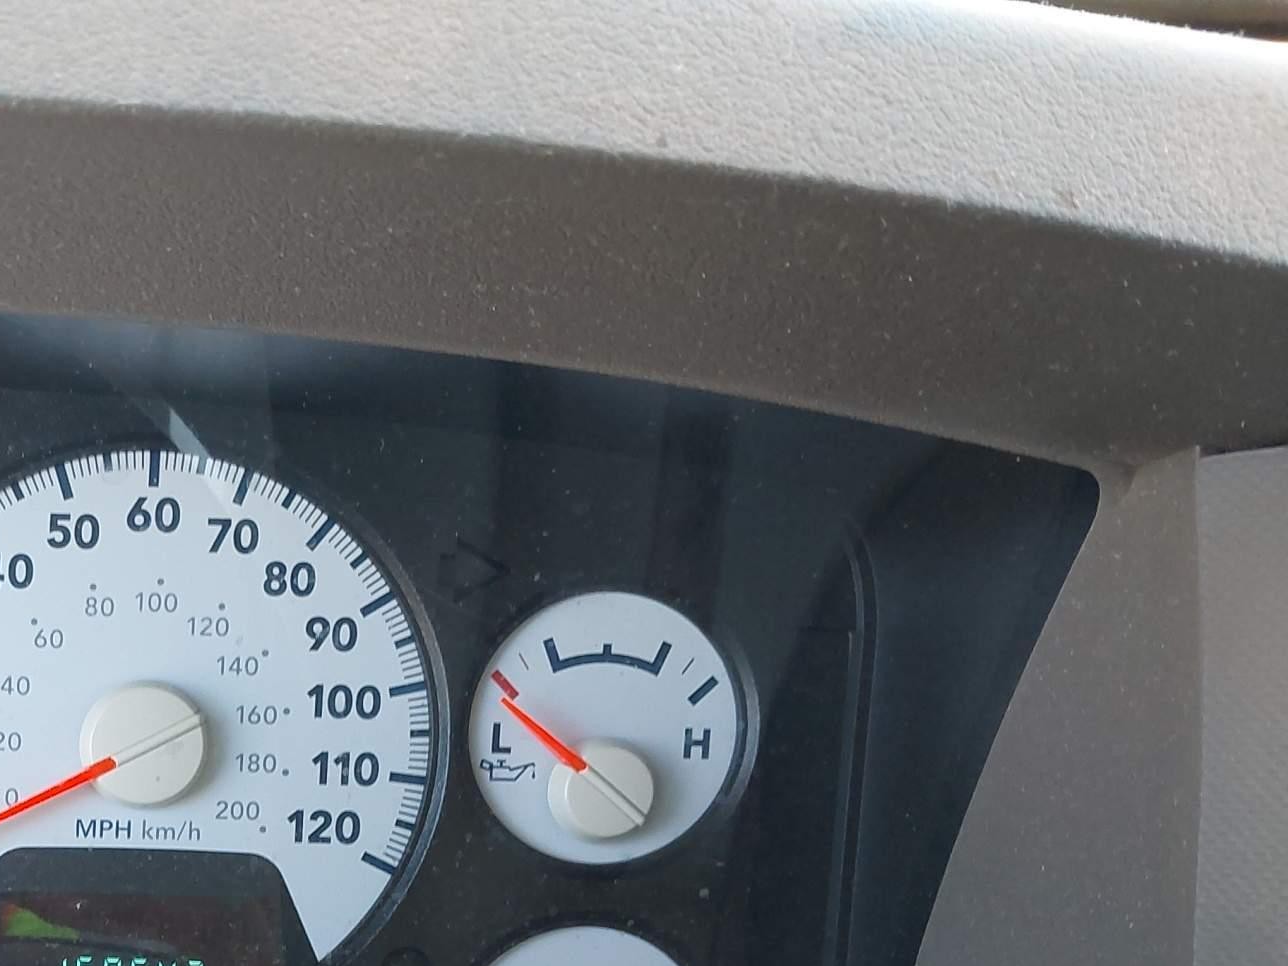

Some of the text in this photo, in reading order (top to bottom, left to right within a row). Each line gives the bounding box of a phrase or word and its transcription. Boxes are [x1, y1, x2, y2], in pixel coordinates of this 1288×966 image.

[126, 496, 181, 534] 60
[46, 513, 100, 550] 50
[207, 517, 259, 555] 70
[263, 560, 316, 598] 80
[84, 596, 115, 617] 80
[135, 591, 178, 613] 100
[34, 628, 64, 649] 60
[187, 616, 230, 637] 120
[305, 617, 358, 653] 90
[216, 655, 259, 676] 140
[0, 675, 31, 696] 40
[236, 704, 278, 725] 160
[307, 684, 382, 720] 100
[491, 722, 512, 755] L
[682, 727, 712, 760] H
[235, 752, 277, 773] 180
[311, 750, 380, 787] 110
[215, 800, 260, 821] 200
[75, 818, 201, 841] MPH km/h
[287, 809, 361, 845] 120
